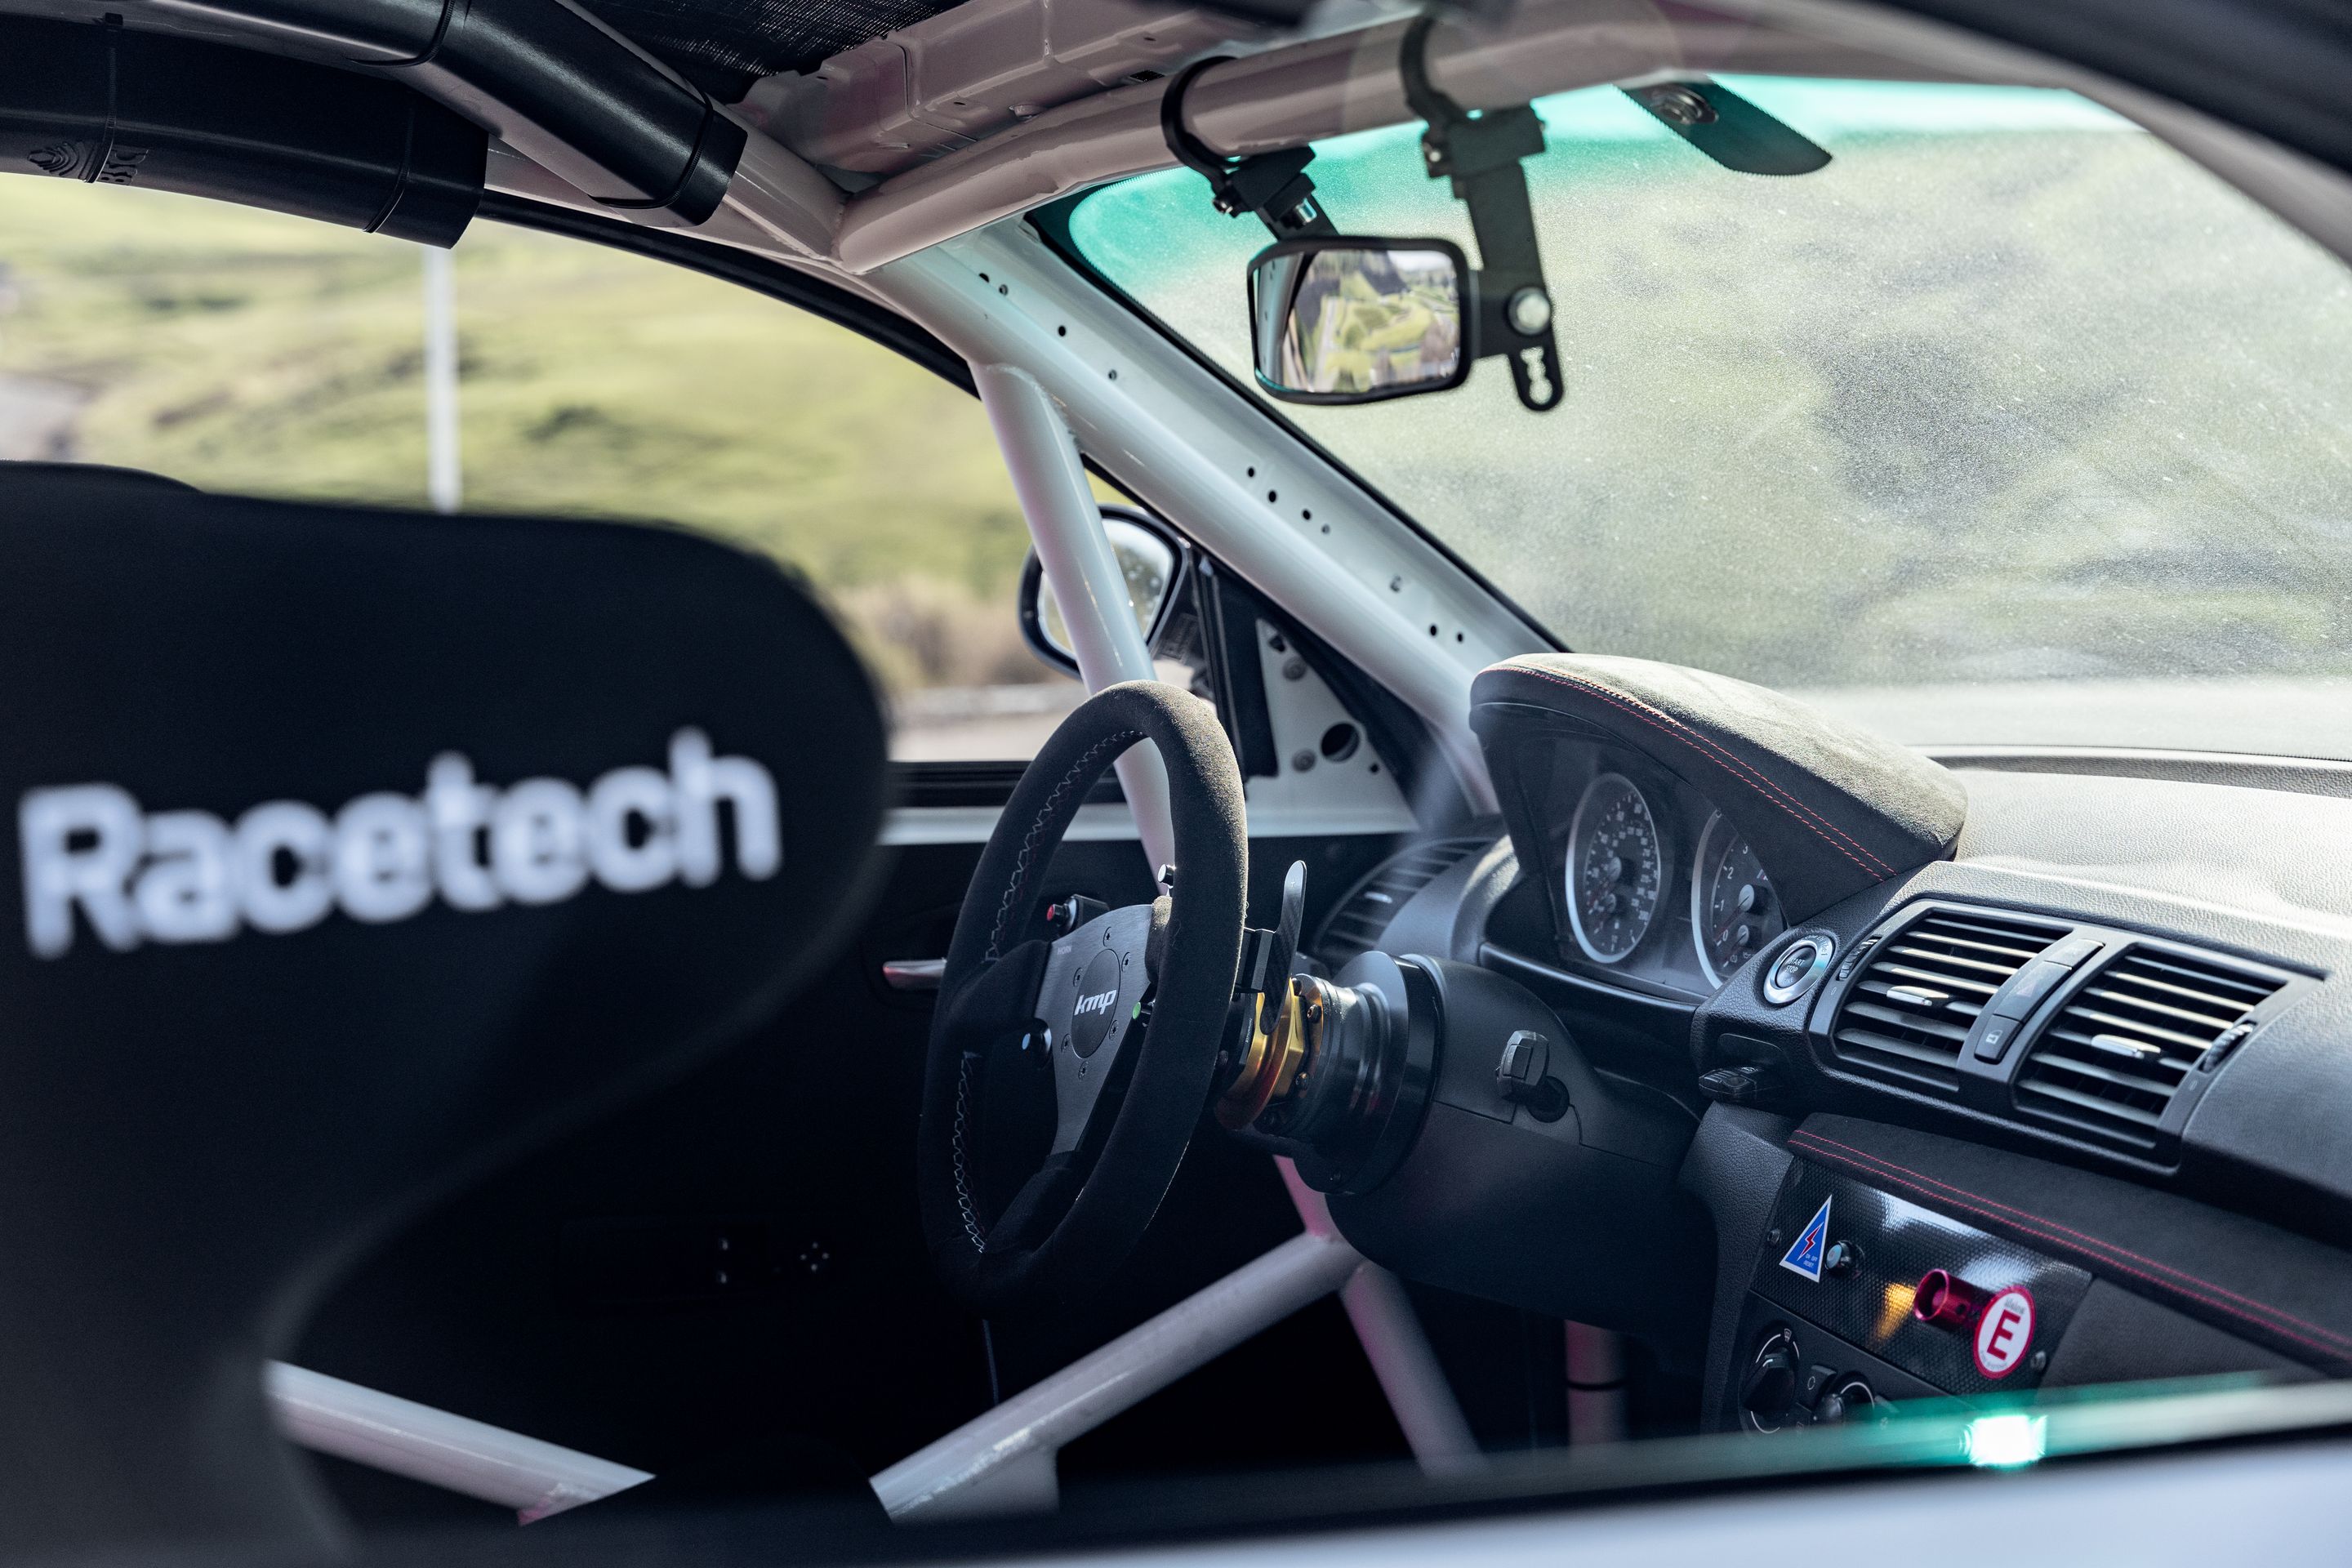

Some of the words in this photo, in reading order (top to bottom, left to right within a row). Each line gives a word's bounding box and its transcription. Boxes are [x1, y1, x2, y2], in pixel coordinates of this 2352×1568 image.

[20, 728, 780, 956] Racetech
[1726, 866, 1734, 880] 2
[1722, 929, 1729, 941] 0
[1784, 964, 1798, 973] STOP
[1788, 958, 1805, 966] START
[1074, 989, 1117, 1016] kmp
[1987, 1309, 2021, 1361] E
